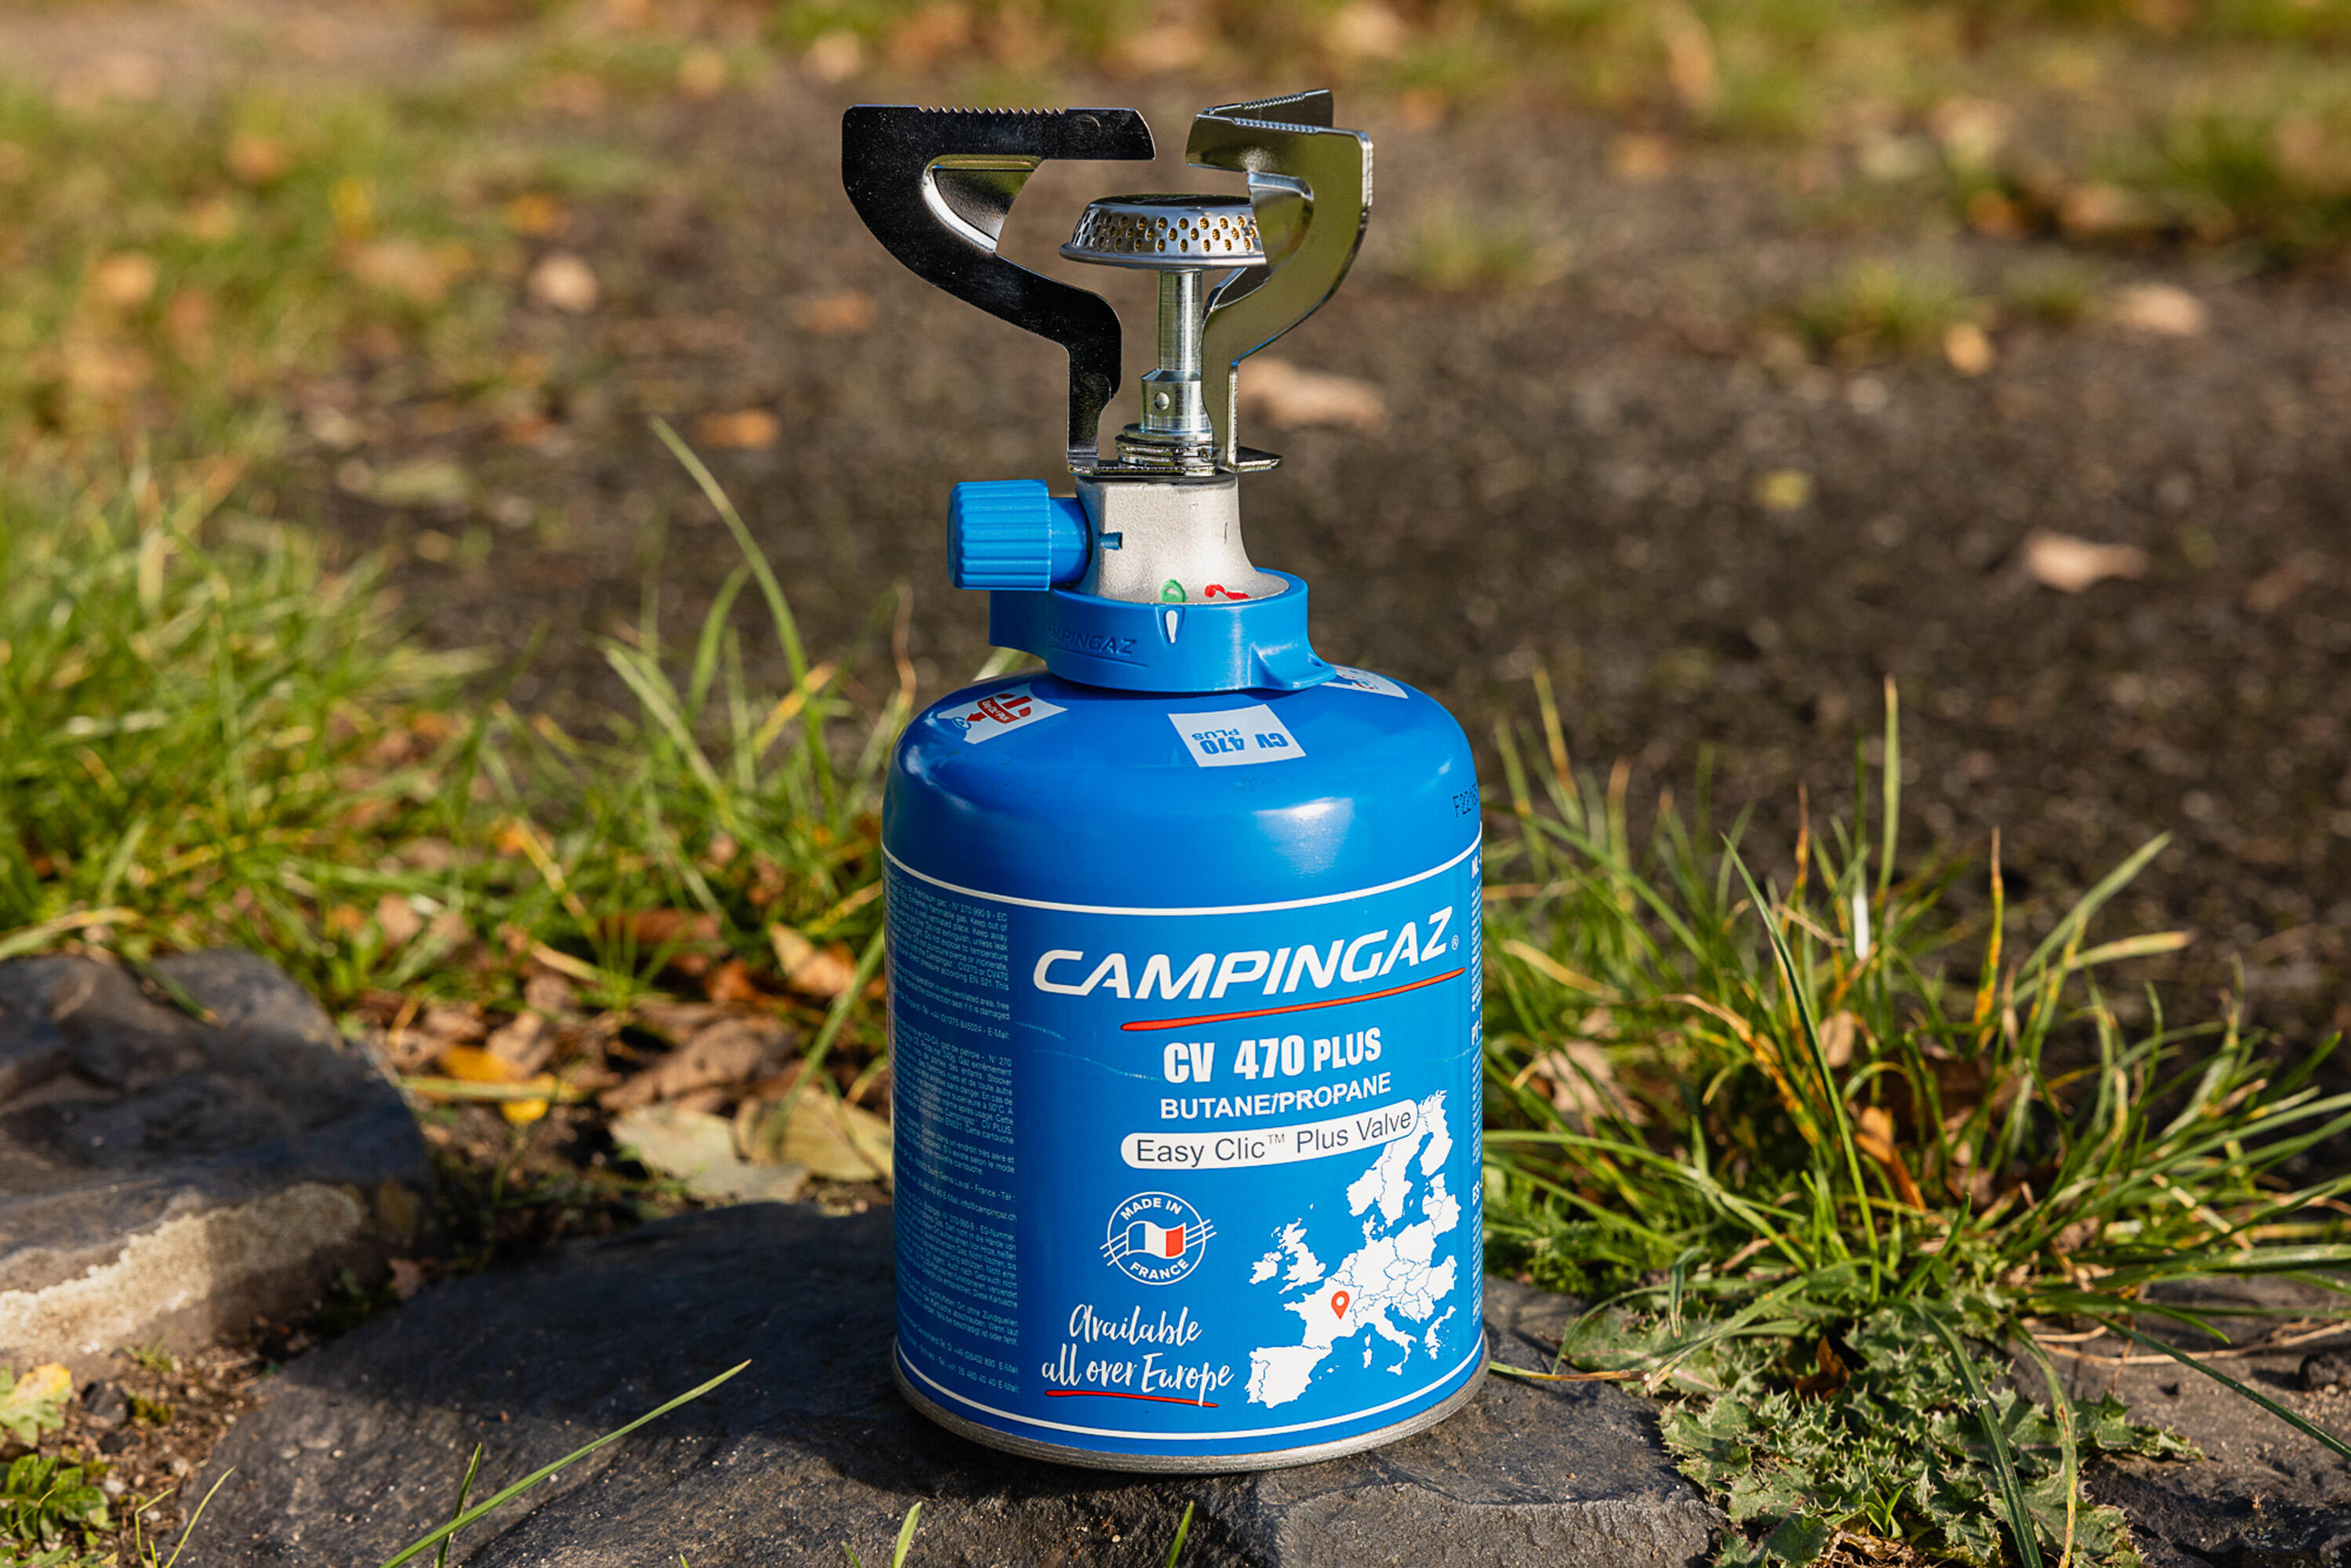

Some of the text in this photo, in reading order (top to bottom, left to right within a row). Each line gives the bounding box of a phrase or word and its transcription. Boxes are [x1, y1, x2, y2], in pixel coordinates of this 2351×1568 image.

[1192, 728, 1240, 741] PLUS
[1199, 732, 1289, 754] CV 470
[1163, 1027, 1382, 1083] CV 470 PLUS
[1160, 1072, 1391, 1119] BUTANE/PROPANE
[1137, 1139, 1204, 1167] Easy
[1297, 1129, 1348, 1153] Plus
[1356, 1112, 1411, 1141] Valve
[1120, 1197, 1182, 1221] MADE IN
[1130, 1258, 1189, 1279] FRANCE
[1069, 1304, 1203, 1346] Available
[1041, 1343, 1235, 1406] all over Europe
